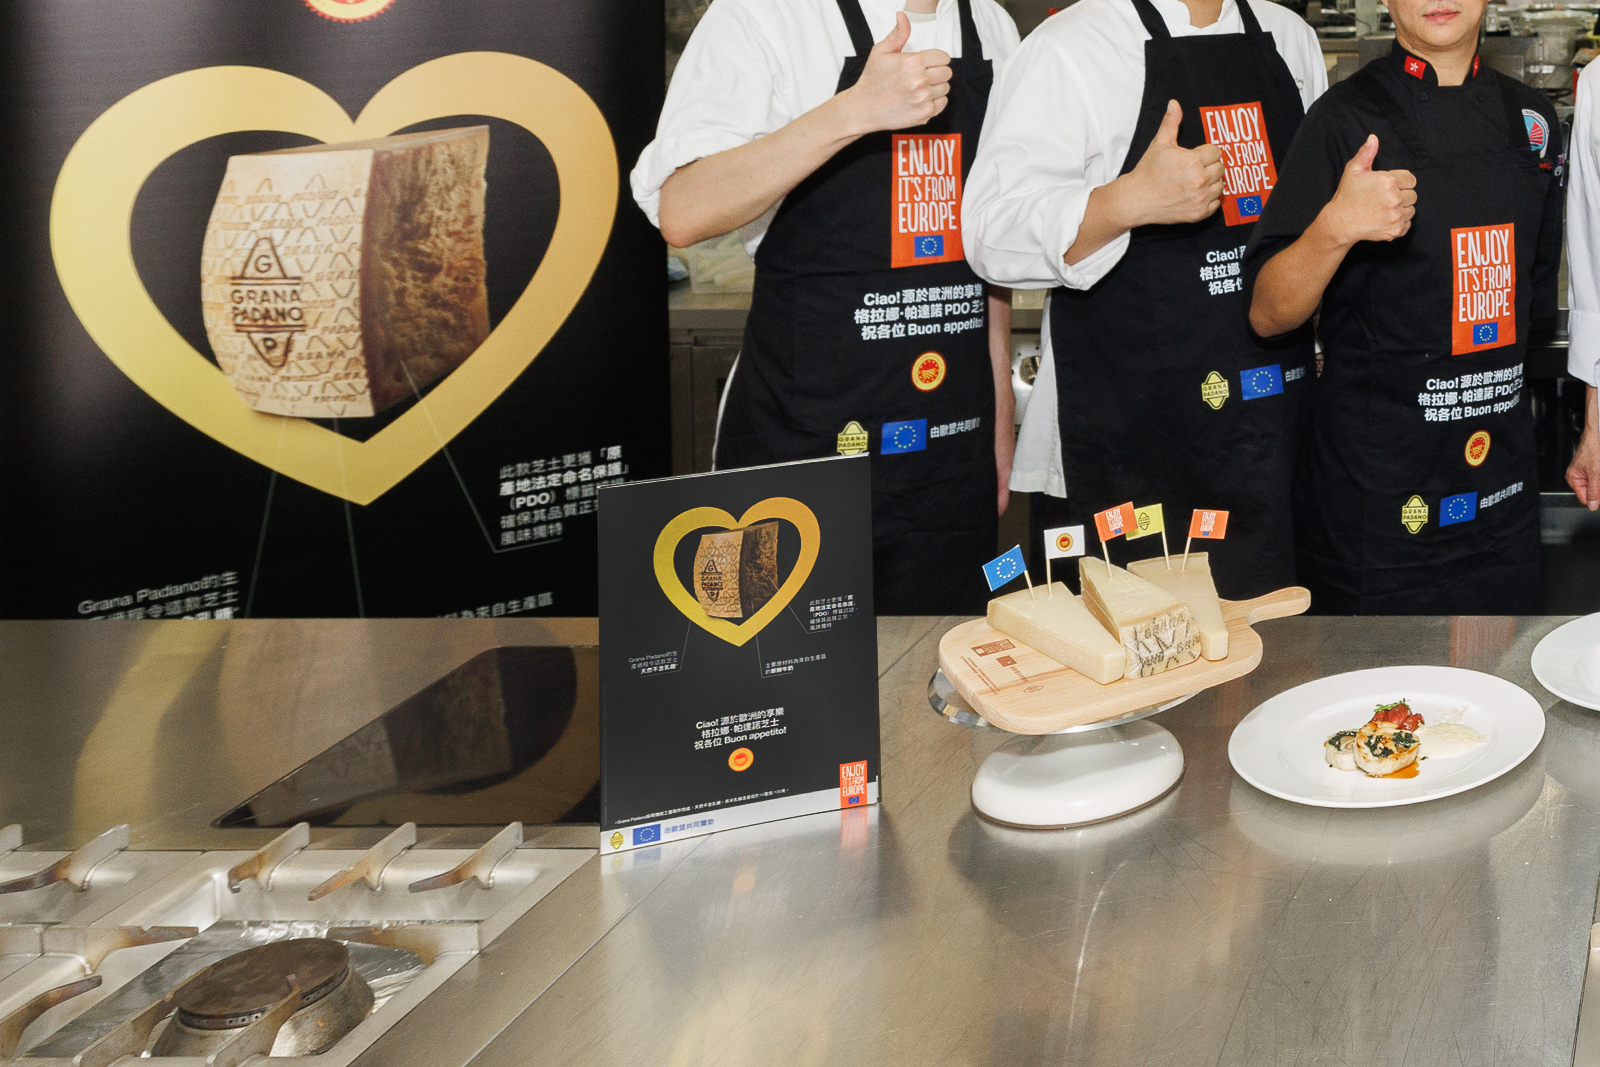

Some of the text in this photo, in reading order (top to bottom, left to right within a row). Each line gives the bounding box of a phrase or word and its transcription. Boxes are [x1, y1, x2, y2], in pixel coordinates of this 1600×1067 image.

[1206, 107, 1260, 144] ENJOY
[898, 139, 955, 176] ENJOY
[1234, 140, 1267, 166] FROM
[898, 176, 956, 202] IT'S FROM
[898, 201, 957, 233] EUROPE
[1206, 247, 1239, 263] Ciao!
[1457, 229, 1509, 268] ENJOY
[254, 254, 273, 273] G
[1200, 262, 1241, 281] 格拉娜
[1458, 264, 1511, 292] IT'S FROM
[231, 289, 301, 305] GRANA
[863, 283, 983, 306] Ciao! 源於歐洲的享樂
[944, 302, 970, 316] PDO
[1459, 288, 1511, 322] EUROPE
[861, 323, 906, 340] 祝各位
[907, 323, 941, 336] Buon
[1203, 383, 1227, 391] GRANA
[1203, 389, 1228, 397] PADANO
[1426, 377, 1459, 390] Ciao!
[1495, 382, 1514, 397] PDO
[1424, 407, 1463, 421] 祝各位
[1464, 404, 1492, 417] Buon
[77, 594, 134, 614] Grana
[696, 719, 719, 729] Ciao!
[694, 726, 787, 750] 祝各位 Buon appetito!
[842, 764, 865, 778] ENJOY
[843, 784, 865, 796] EUROPE
